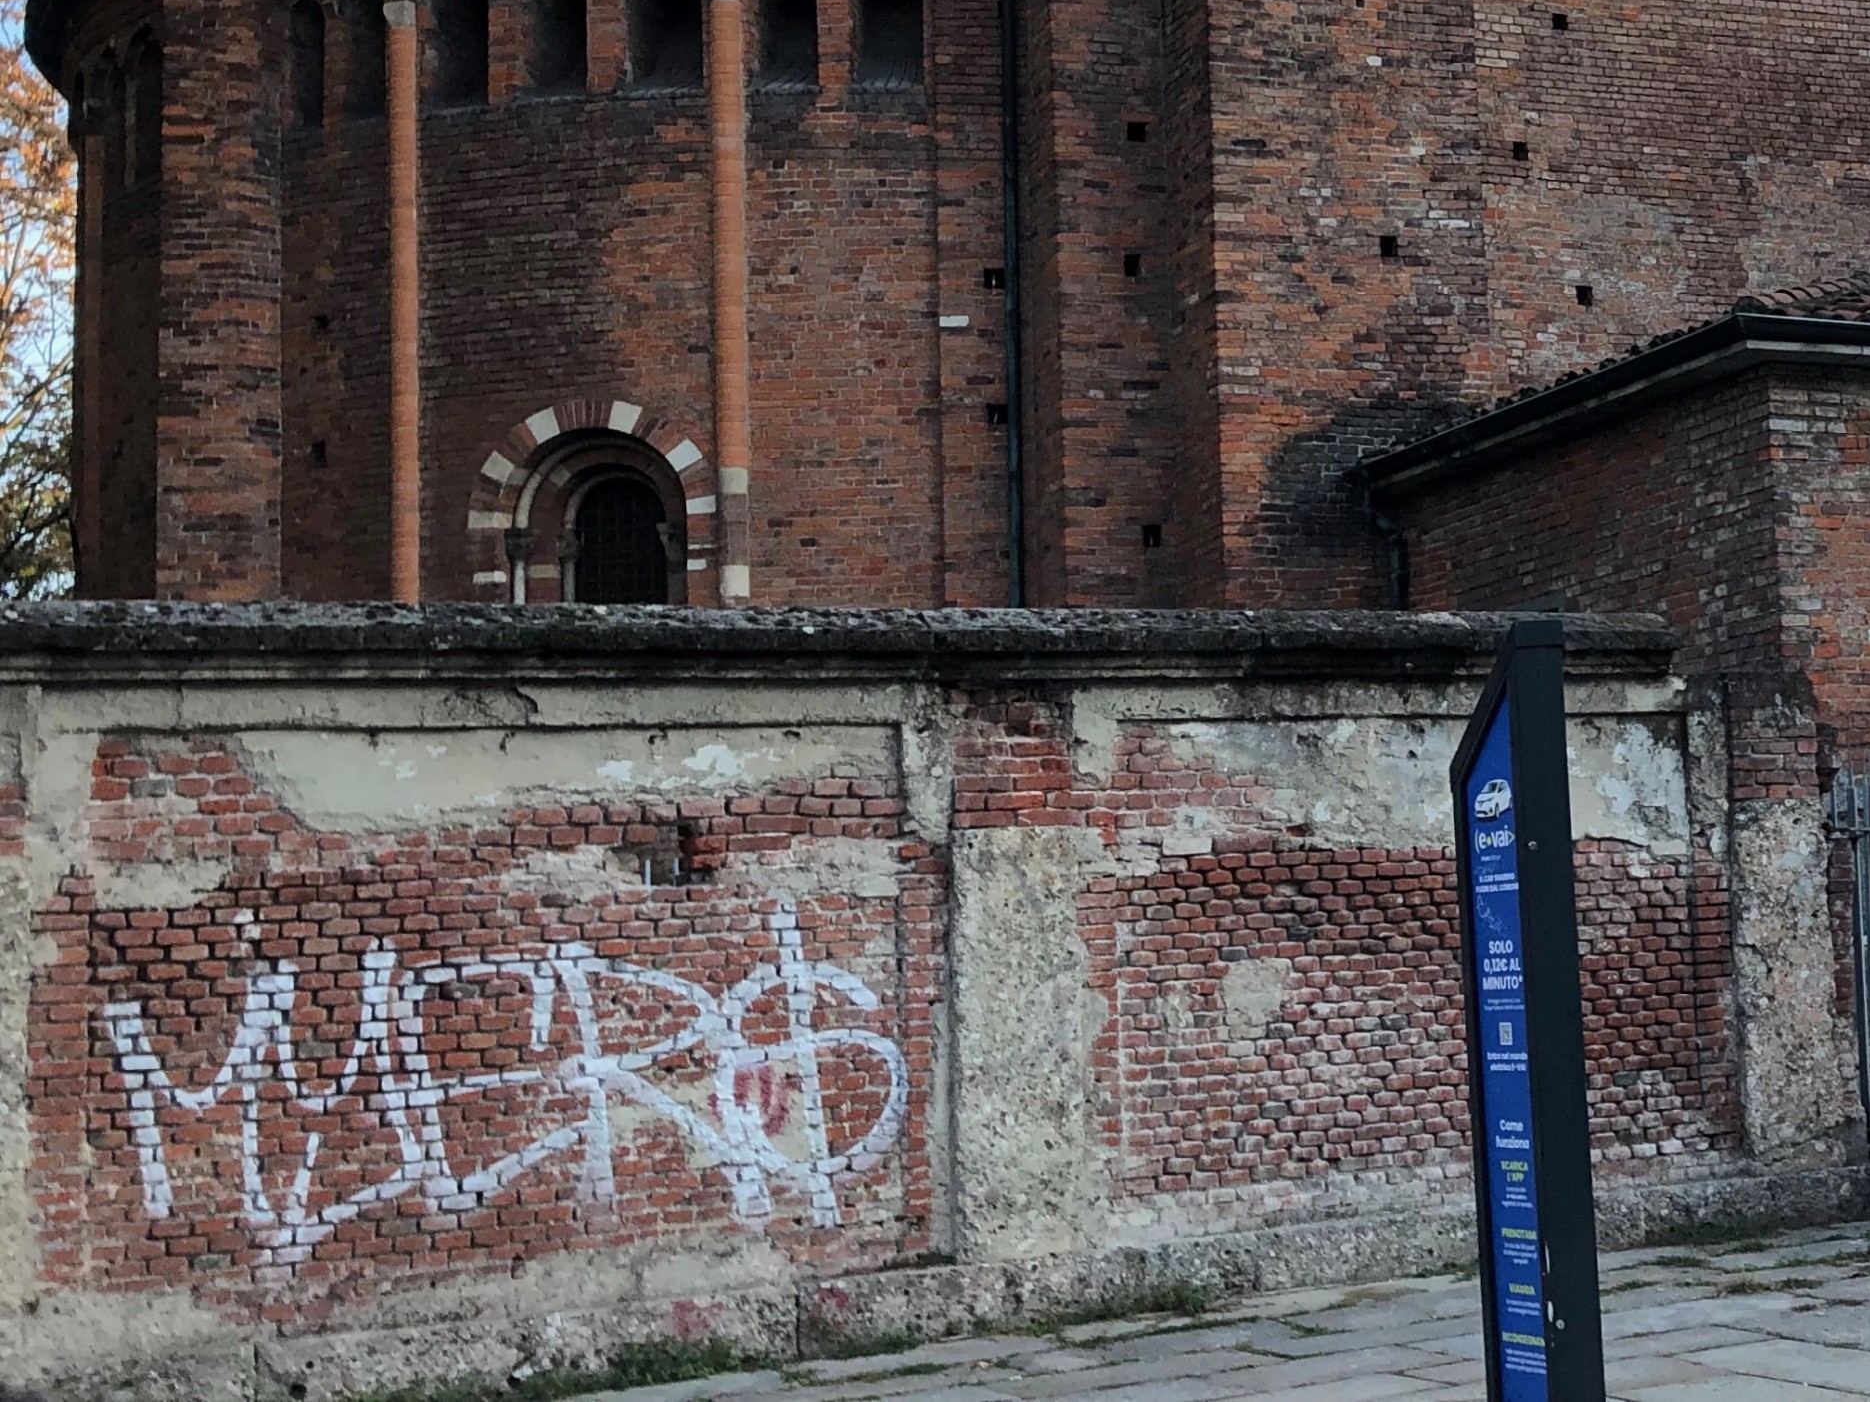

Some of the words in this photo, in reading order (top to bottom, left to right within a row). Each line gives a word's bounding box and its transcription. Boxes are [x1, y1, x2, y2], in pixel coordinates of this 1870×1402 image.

[1488, 939, 1513, 954] SOLO
[1483, 958, 1508, 974] 0,12€
[1509, 957, 1521, 971] AL
